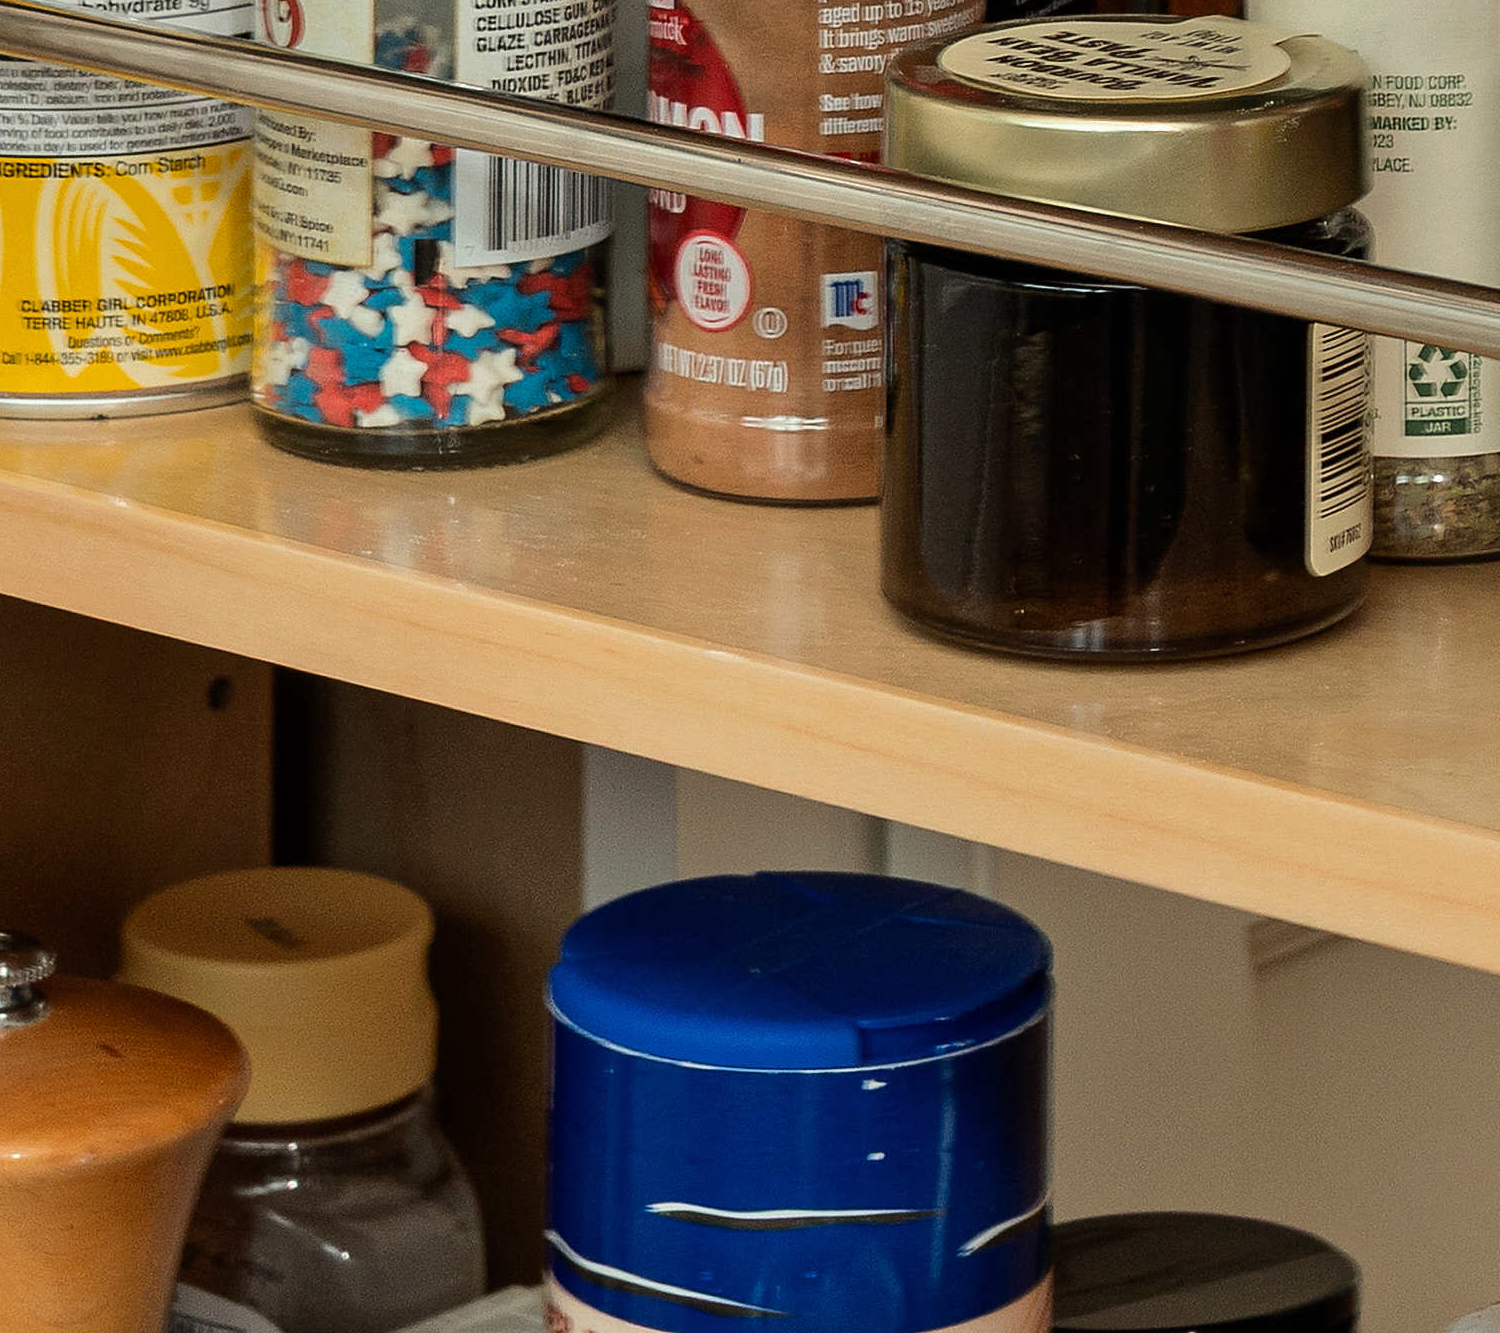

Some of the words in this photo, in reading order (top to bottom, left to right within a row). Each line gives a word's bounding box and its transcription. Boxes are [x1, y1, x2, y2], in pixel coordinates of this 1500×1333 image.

[475, 6, 561, 32] CELLULOSE
[818, 2, 861, 28] aged
[475, 32, 529, 53] GLAZE,
[836, 27, 885, 51] brings
[887, 24, 925, 44] warm
[986, 36, 1084, 63] BEAN
[1040, 31, 1156, 60] PASTE
[506, 48, 573, 73] LECITHIN,
[836, 52, 887, 75] savory
[985, 54, 1147, 91] BOURBON
[1082, 57, 1225, 89] VANILLA
[1386, 74, 1424, 91] FOOD
[1428, 73, 1467, 90] CORP.
[1430, 91, 1474, 108] 08832
[157, 155, 207, 174] Starch
[290, 142, 369, 169] Marketplace
[1374, 157, 1415, 173] LACE.
[300, 215, 335, 234] Spice
[20, 299, 93, 314] CLABBER
[136, 283, 236, 309] CORPORATION
[23, 316, 71, 330] TERRE
[75, 314, 129, 330] HAUTE,
[195, 302, 233, 320] U.S.A.
[67, 334, 122, 350] Questions
[138, 325, 201, 345] Comments?
[725, 357, 747, 387] OZ
[748, 359, 789, 393] (67g)
[1410, 404, 1467, 418] PLASTIC
